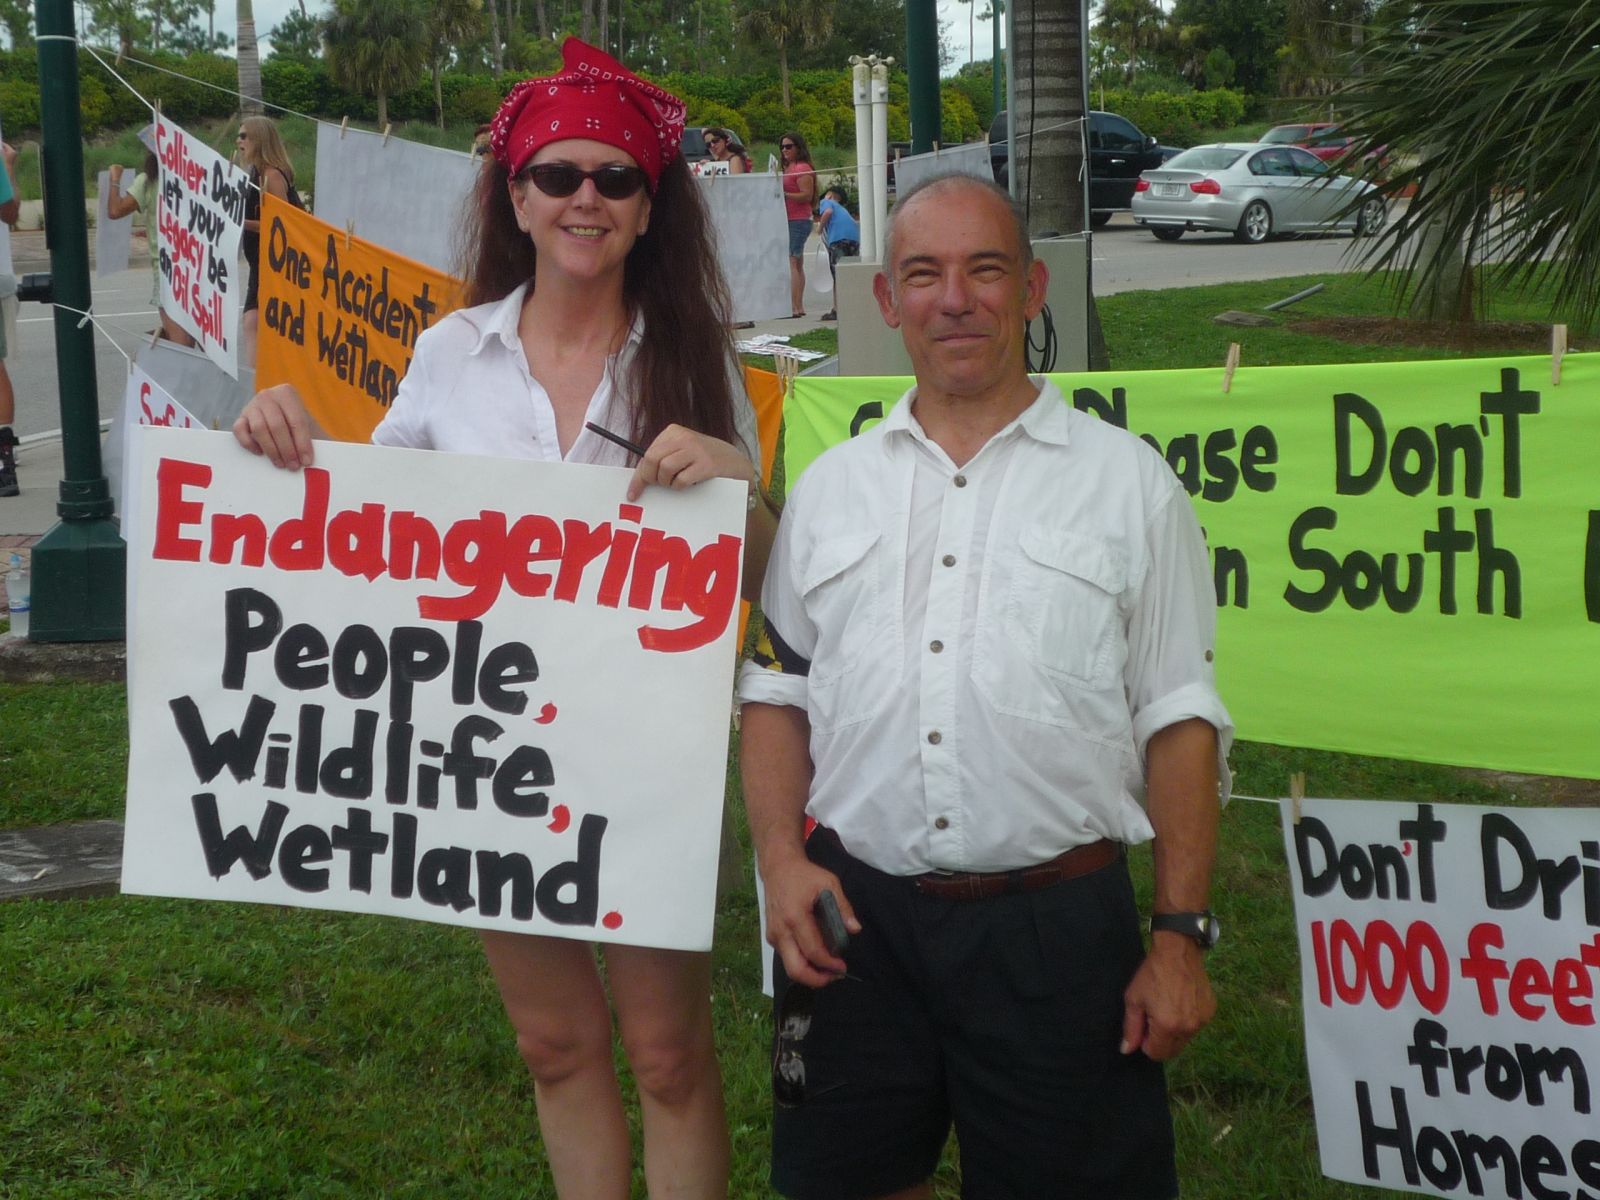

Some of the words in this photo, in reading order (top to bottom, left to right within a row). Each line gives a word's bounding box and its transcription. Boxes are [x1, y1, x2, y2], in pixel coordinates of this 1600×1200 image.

[159, 194, 204, 282] Legacy
[207, 244, 228, 293] be
[162, 168, 183, 217] let
[188, 199, 226, 247] your
[159, 248, 173, 286] an
[173, 265, 189, 314] Oil
[265, 297, 305, 346] and
[268, 216, 312, 289] One
[321, 233, 437, 350] Accident
[1333, 367, 1541, 499] Don't
[152, 457, 743, 653] Endangering
[1283, 506, 1522, 619] South
[221, 587, 558, 725] People,
[169, 694, 573, 833] Wildlife,
[191, 792, 624, 930] Wetland.
[1294, 804, 1447, 903] Don't
[1311, 919, 1450, 1015] 1000
[1407, 1018, 1591, 1115] from
